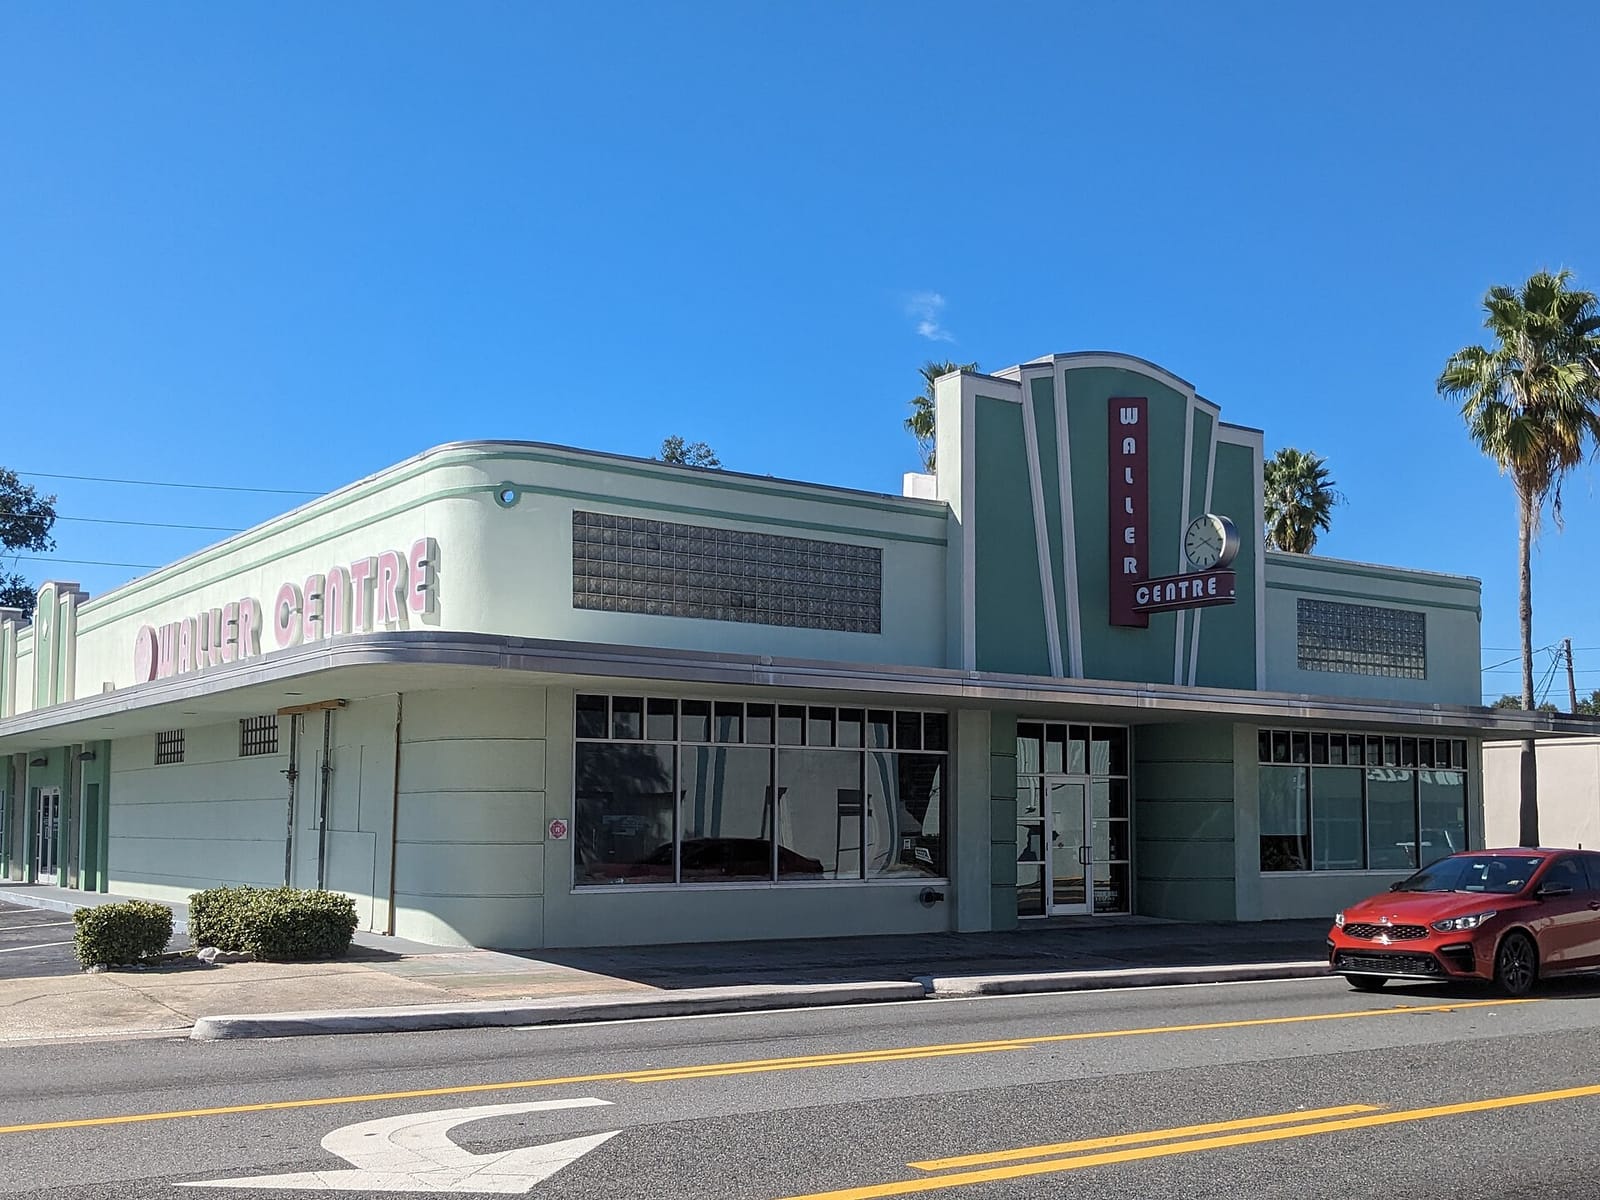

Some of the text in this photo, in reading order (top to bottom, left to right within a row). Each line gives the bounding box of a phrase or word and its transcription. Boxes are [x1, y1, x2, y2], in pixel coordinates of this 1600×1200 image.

[1120, 407, 1139, 574] WALLER
[158, 537, 438, 678] WALLER CENTRE
[1136, 577, 1217, 605] CENTRE
